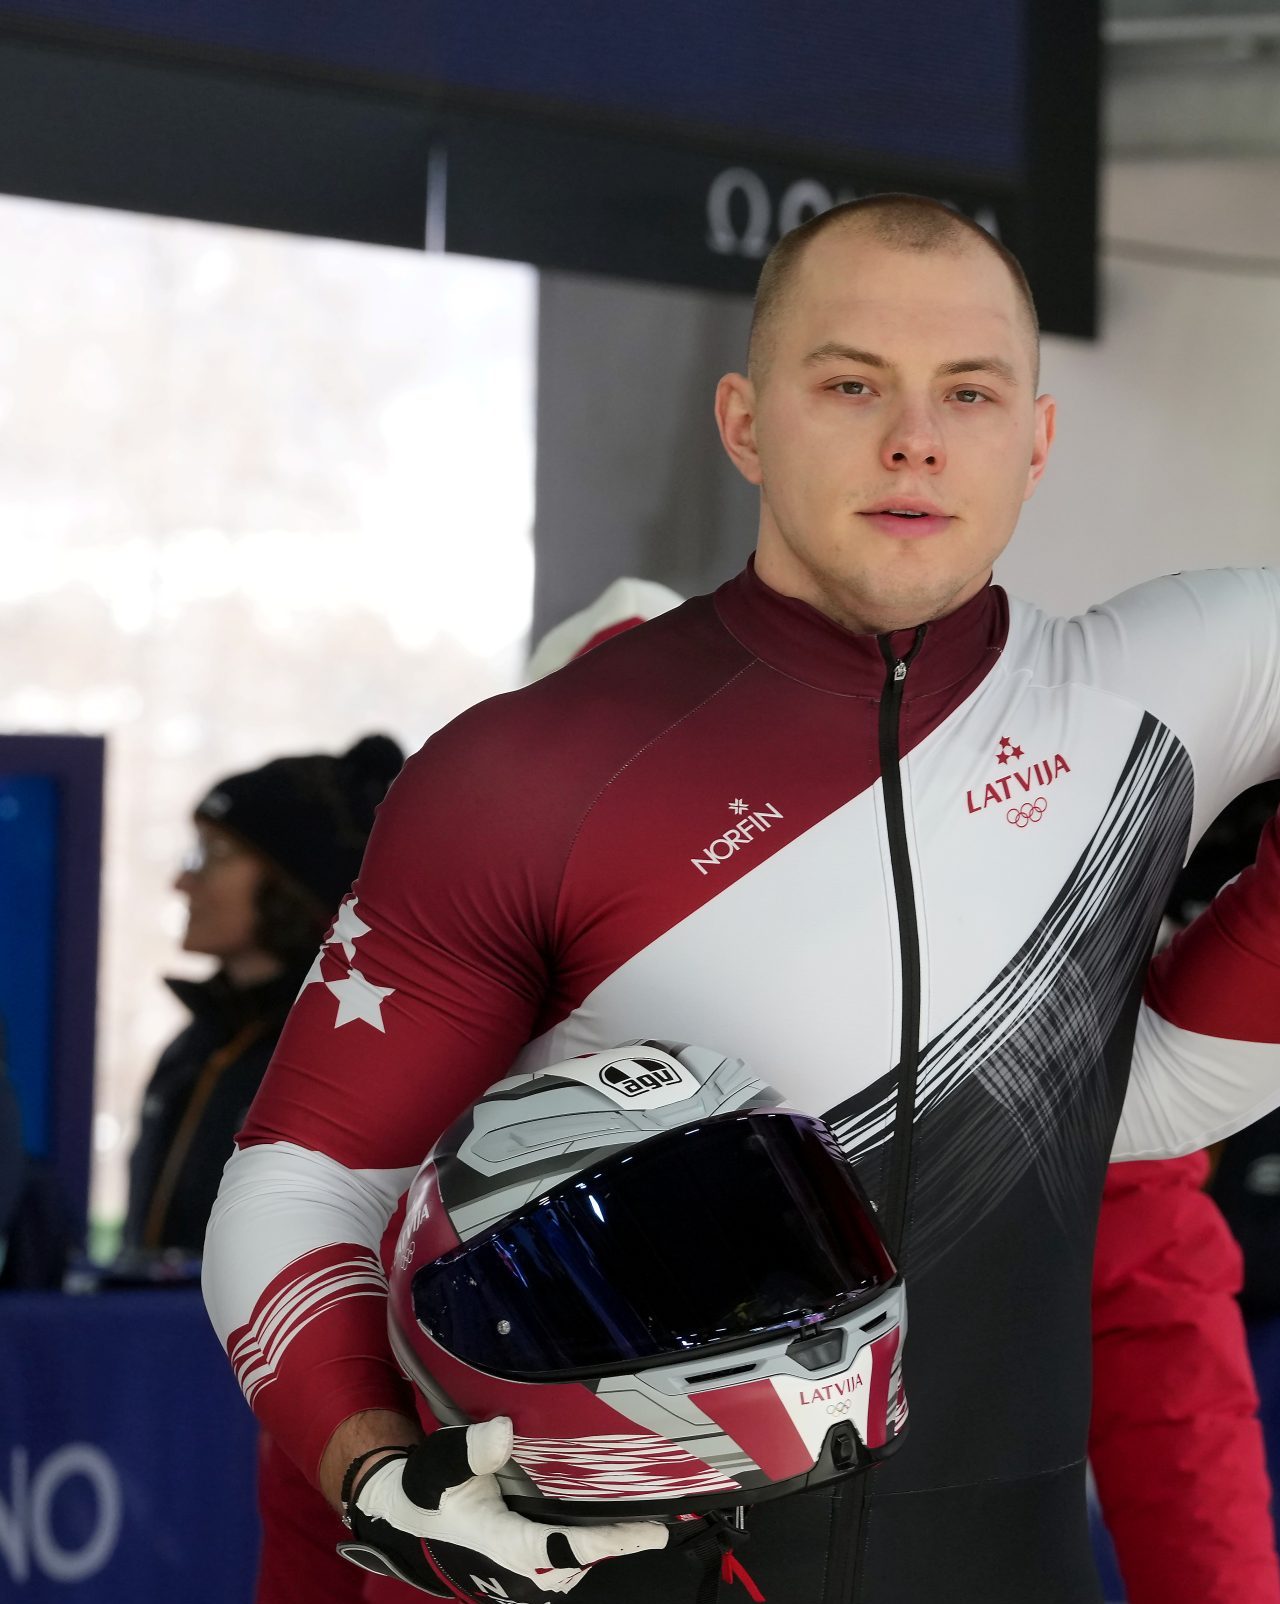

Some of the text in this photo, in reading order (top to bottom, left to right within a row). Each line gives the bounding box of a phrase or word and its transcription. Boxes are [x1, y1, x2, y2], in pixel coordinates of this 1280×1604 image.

[966, 753, 1071, 814] LATVIJA
[691, 802, 784, 875] NORFIN
[622, 1069, 674, 1093] agv
[799, 1373, 864, 1406] LATVIJA
